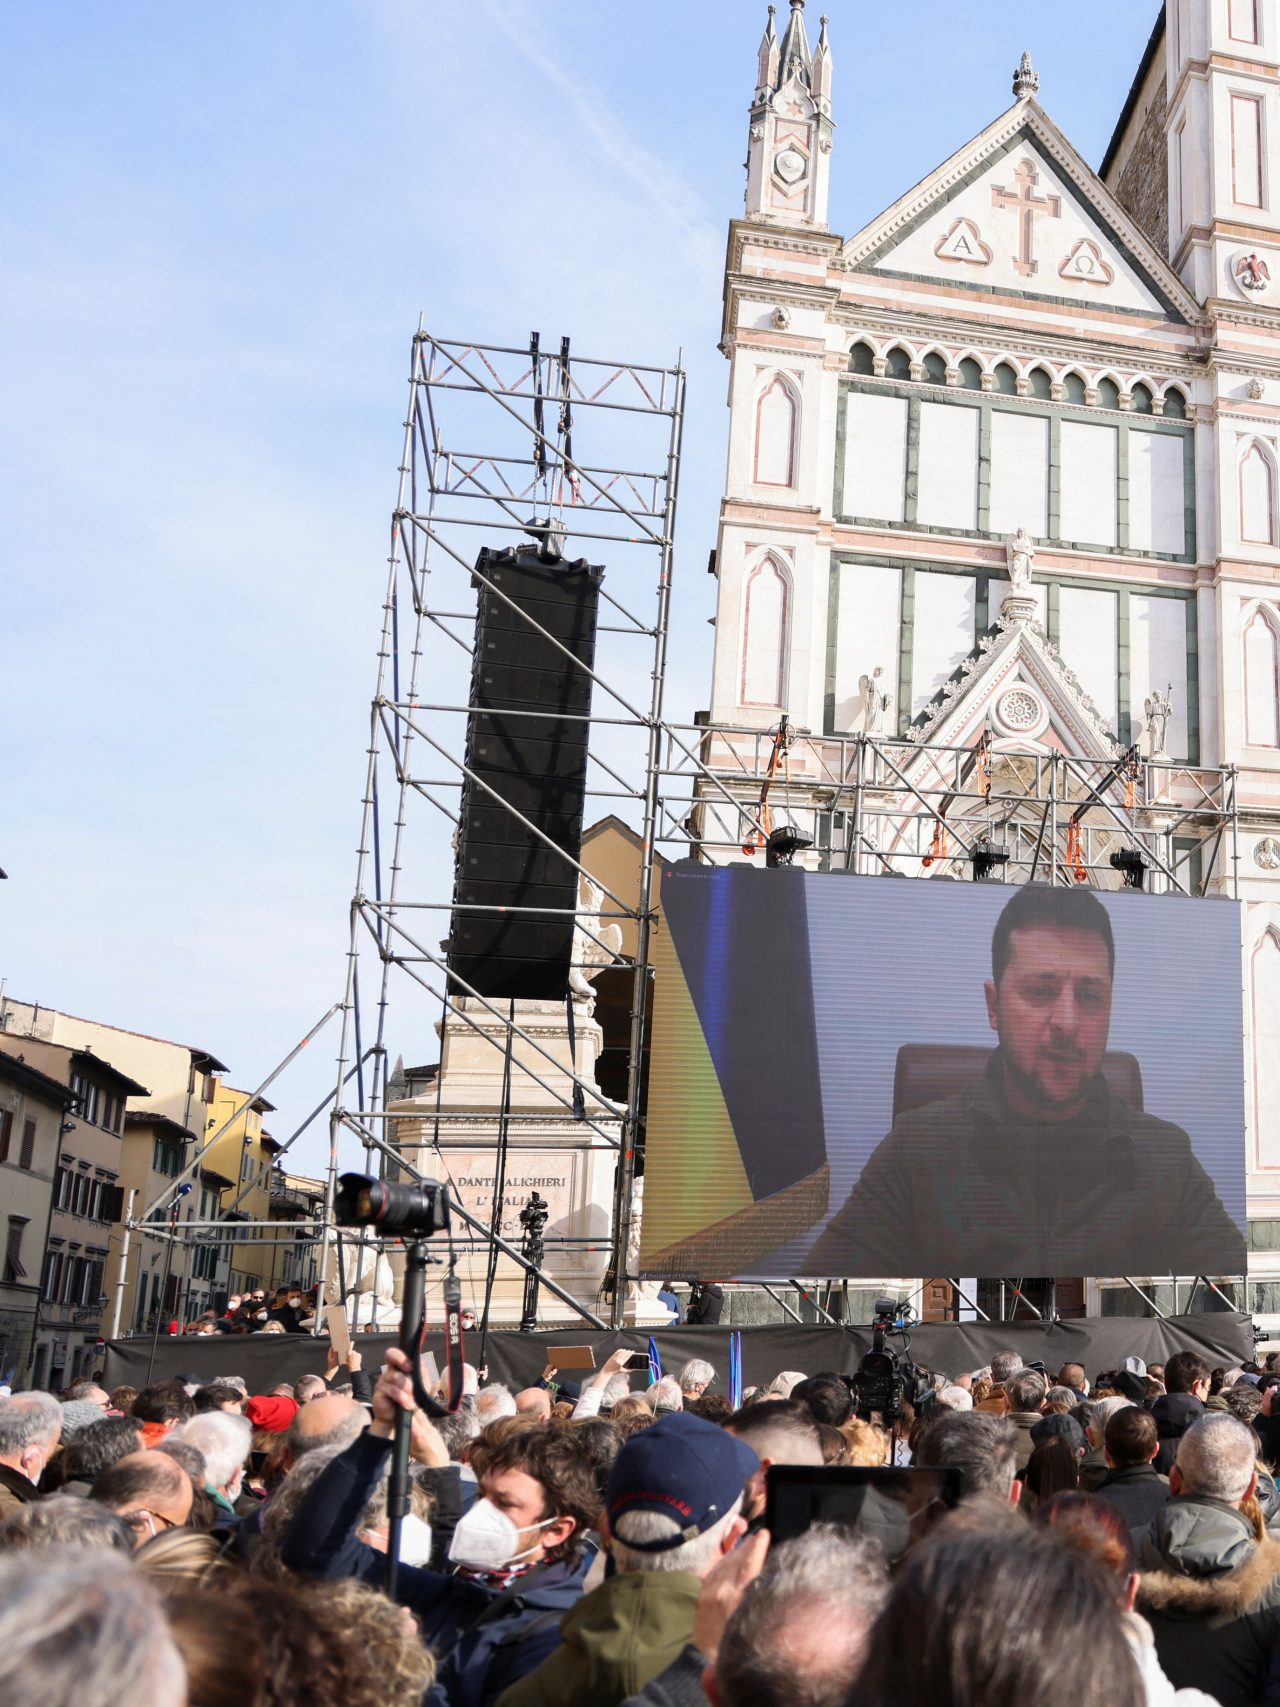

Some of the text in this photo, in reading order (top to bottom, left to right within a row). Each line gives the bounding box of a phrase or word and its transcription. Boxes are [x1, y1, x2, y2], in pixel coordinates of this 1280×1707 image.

[1074, 255, 1095, 274] Ω
[458, 1178, 497, 1187] DANTE
[504, 1177, 566, 1187] ALIGHIERI
